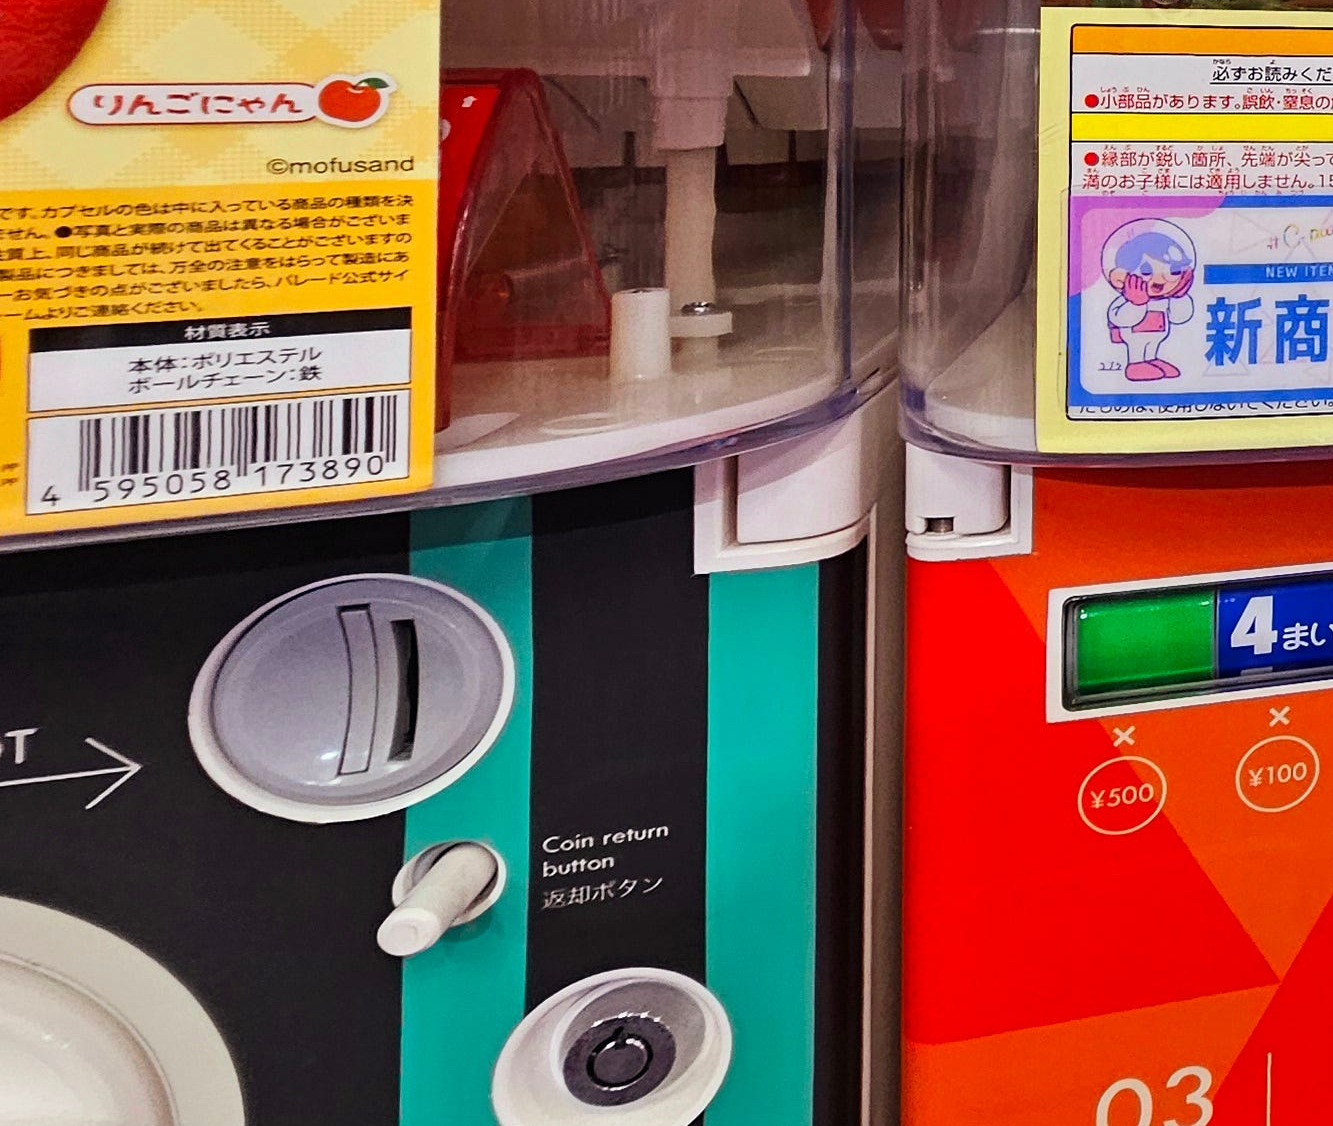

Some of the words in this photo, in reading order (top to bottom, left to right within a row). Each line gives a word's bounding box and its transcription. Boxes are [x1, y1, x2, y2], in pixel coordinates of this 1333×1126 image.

[91, 87, 303, 118] りんごにゃん
[1265, 265, 1299, 279] NEW
[184, 322, 272, 341] 材質表示
[41, 483, 62, 506] 4
[92, 468, 232, 504] 595058
[254, 454, 385, 487] 173890
[1248, 761, 1310, 788] ¥100
[1089, 782, 1155, 810] ¥500
[541, 832, 597, 856] Coin
[601, 822, 671, 847] return
[541, 853, 616, 878] button
[540, 876, 665, 912] 返却ボタン
[1096, 1065, 1214, 1126] 03
